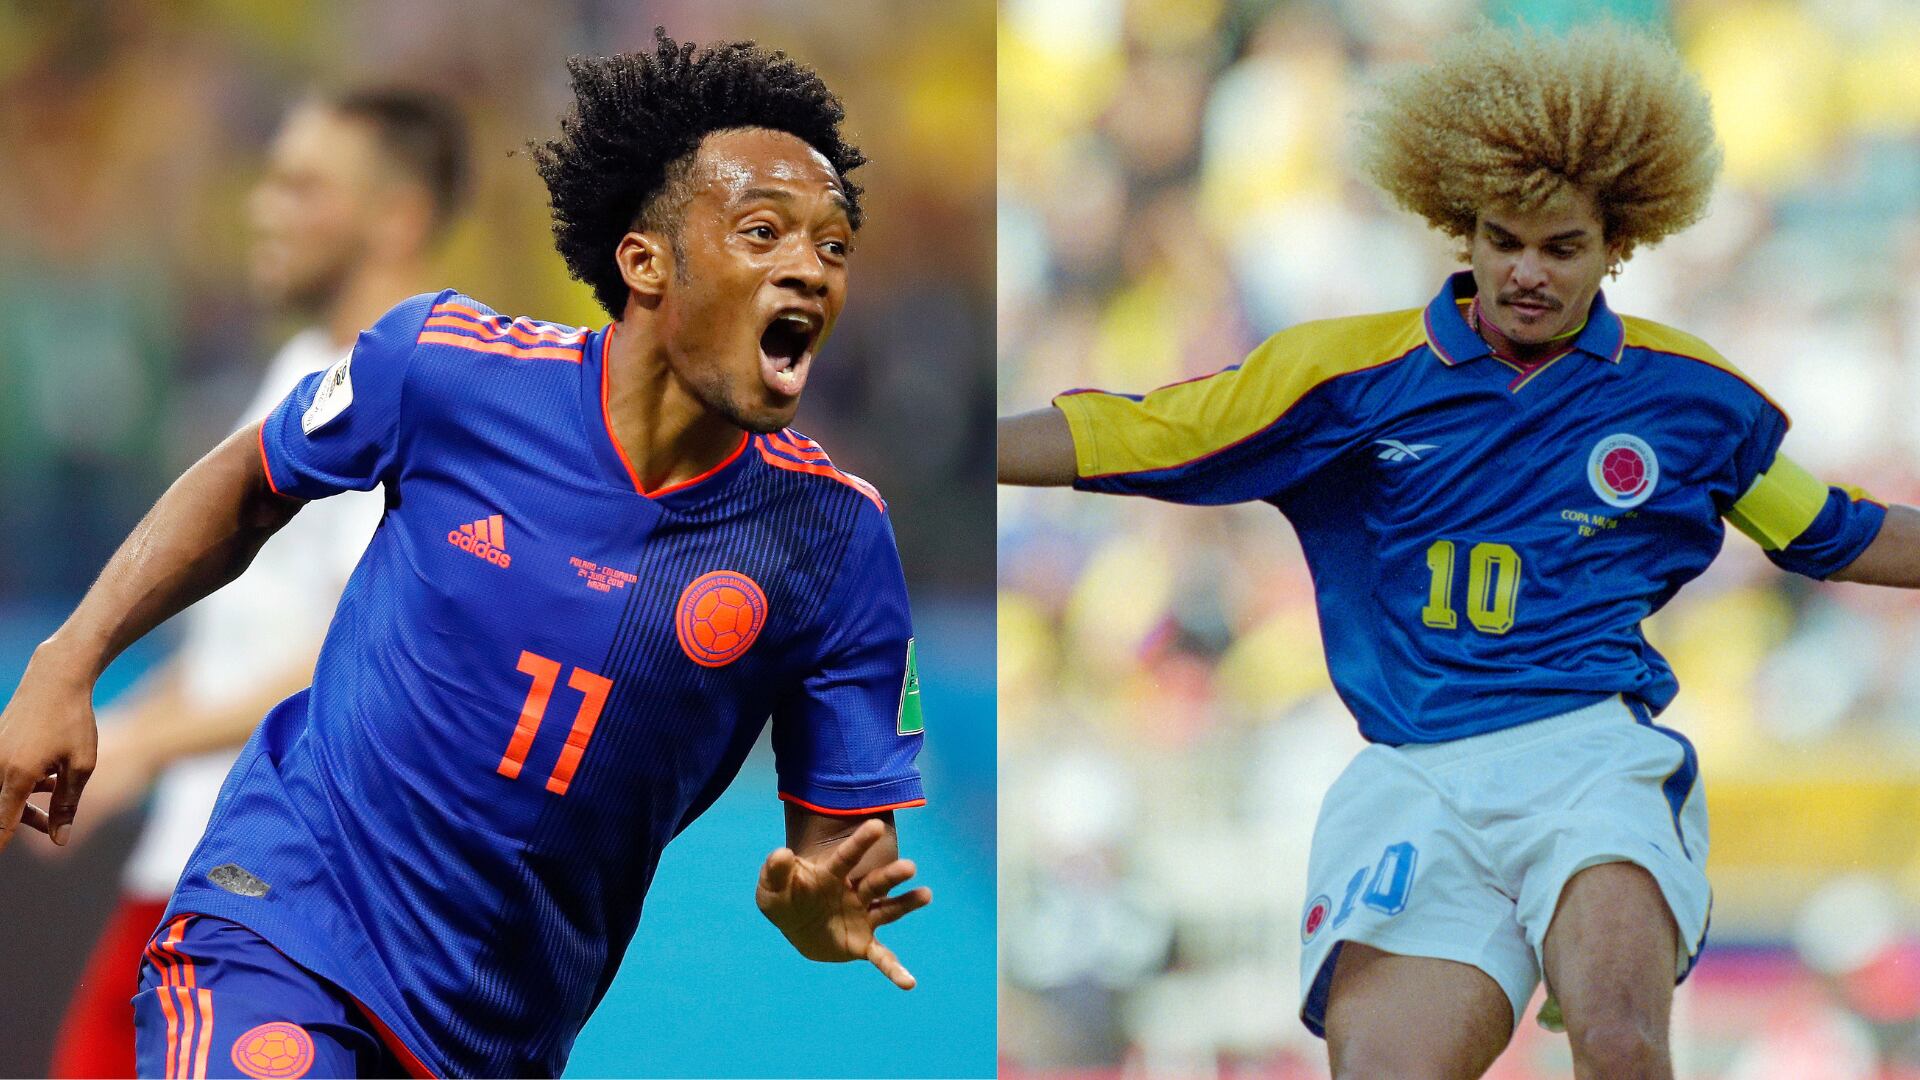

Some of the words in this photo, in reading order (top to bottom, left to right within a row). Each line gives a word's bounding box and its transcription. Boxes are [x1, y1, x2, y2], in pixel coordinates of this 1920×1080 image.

[1561, 509, 1589, 523] COPA
[448, 530, 512, 569] adidas
[569, 556, 597, 571] POLAND
[602, 566, 638, 583] COLOMBIA
[577, 568, 588, 578] 24
[588, 571, 607, 583] JUNE
[607, 577, 625, 588] 2018
[1422, 540, 1522, 634] 10
[496, 650, 614, 796] 11
[1332, 841, 1418, 917] 10
